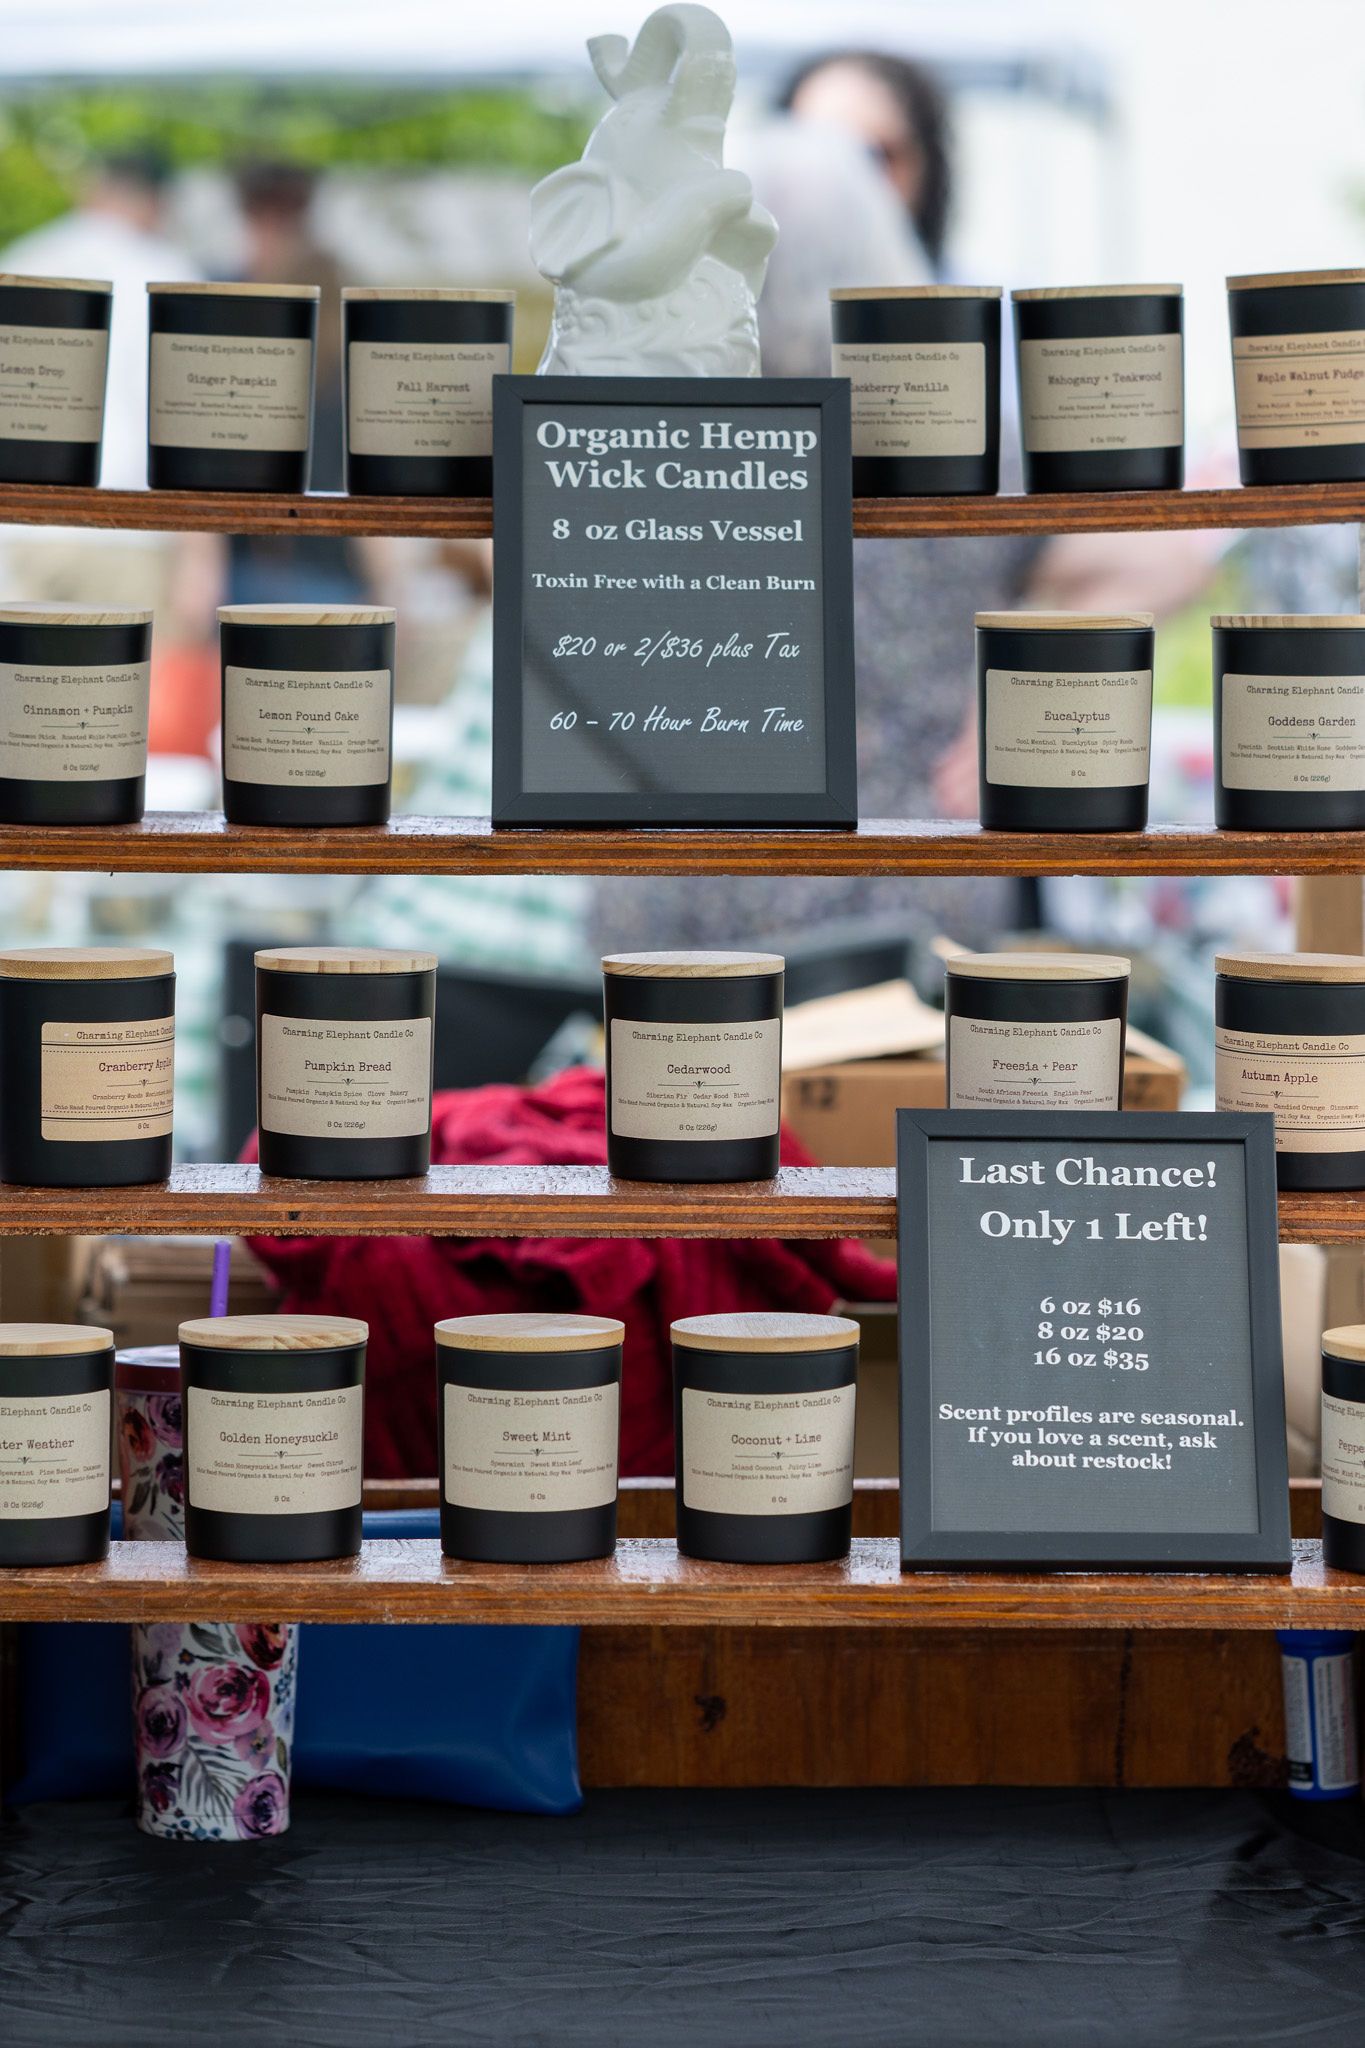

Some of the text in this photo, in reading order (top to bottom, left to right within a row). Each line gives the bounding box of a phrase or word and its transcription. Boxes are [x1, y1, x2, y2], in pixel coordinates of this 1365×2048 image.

[187, 374, 277, 387] Ginger Pumpkin
[1048, 376, 1100, 386] Mahogany
[1112, 372, 1162, 383] Teakwood
[1257, 373, 1286, 384] Maple
[1290, 371, 1329, 380] Walnut
[397, 382, 470, 392] Fall Harvest
[851, 383, 949, 394] lackberry Vanilla
[536, 421, 817, 457] Organic Hemp
[545, 460, 808, 490] Wick Candles
[552, 519, 803, 541] 8 oz Glass Vessel
[532, 573, 815, 590] Toxin Free with a Clean Burn
[553, 630, 800, 667] $20 or 2/$36 plus Tax
[15, 674, 58, 684] Charming
[61, 676, 103, 685] Elephant
[106, 674, 131, 682] Candle
[245, 678, 284, 689] Charming
[288, 681, 330, 690] Elephant
[1011, 677, 1053, 687] Charming
[1056, 679, 1100, 688] Elephant
[1130, 678, 1137, 686] Co
[1247, 686, 1289, 696] Charming
[1292, 687, 1335, 696] Elephant
[23, 705, 80, 715] Cinnamon
[93, 705, 132, 717] Pumpkin
[259, 709, 359, 721] Lemon Pound Cake
[1044, 711, 1110, 723] Eucalyptus
[550, 711, 577, 730] 60
[609, 712, 635, 731] 70
[643, 705, 692, 732] Hour
[700, 707, 749, 733] Burn
[761, 707, 804, 732] Time
[1268, 717, 1355, 726] Goddess Garden
[77, 1029, 159, 1040] Charming Elephant
[282, 1027, 323, 1039] Charming
[326, 1030, 371, 1040] Elephant
[373, 1030, 403, 1039] Candle
[632, 1031, 673, 1042] Charming
[676, 1034, 721, 1043] Elephant
[723, 1032, 753, 1042] Candle
[970, 1025, 1010, 1037] Charming
[1013, 1028, 1057, 1038] Elephant
[1060, 1028, 1090, 1036] Candle
[1224, 1036, 1254, 1048] Charming
[1257, 1040, 1300, 1050] Elephant
[99, 1058, 171, 1072] Cranberry Apple
[305, 1060, 391, 1073] Pumpkin Bread
[667, 1064, 730, 1074] Cedarwood
[993, 1060, 1039, 1071] Freesia
[1052, 1062, 1078, 1071] Pear
[1242, 1070, 1318, 1085] Autumn Apple
[960, 1158, 1216, 1188] Last Chance!
[980, 1210, 1208, 1245] Only 1 Left!
[1040, 1297, 1141, 1318] 6 oz $16
[1038, 1322, 1144, 1343] 8 oz $20
[1034, 1348, 1149, 1370] 16 oz $35
[211, 1397, 254, 1409] Charming
[257, 1400, 303, 1410] Elephant
[306, 1398, 336, 1406] Candle
[468, 1394, 510, 1407] Charming
[514, 1397, 560, 1407] Elephant
[563, 1395, 592, 1404] Candle
[707, 1398, 751, 1410] Charming
[754, 1401, 800, 1411] Elephant
[803, 1398, 831, 1407] Candle
[1, 1408, 48, 1417] Elephant
[50, 1406, 81, 1415] Candle
[939, 1404, 1244, 1427] Scent profiles are seasonal.
[220, 1431, 339, 1446] Golden Honeysuckle
[503, 1432, 571, 1441] Sweet Mint
[731, 1434, 782, 1445] Coconut
[795, 1434, 822, 1444] Lime
[968, 1427, 1217, 1450] If you love a scent, ask
[27, 1439, 74, 1449] Weather
[1012, 1450, 1172, 1470] about restock!
